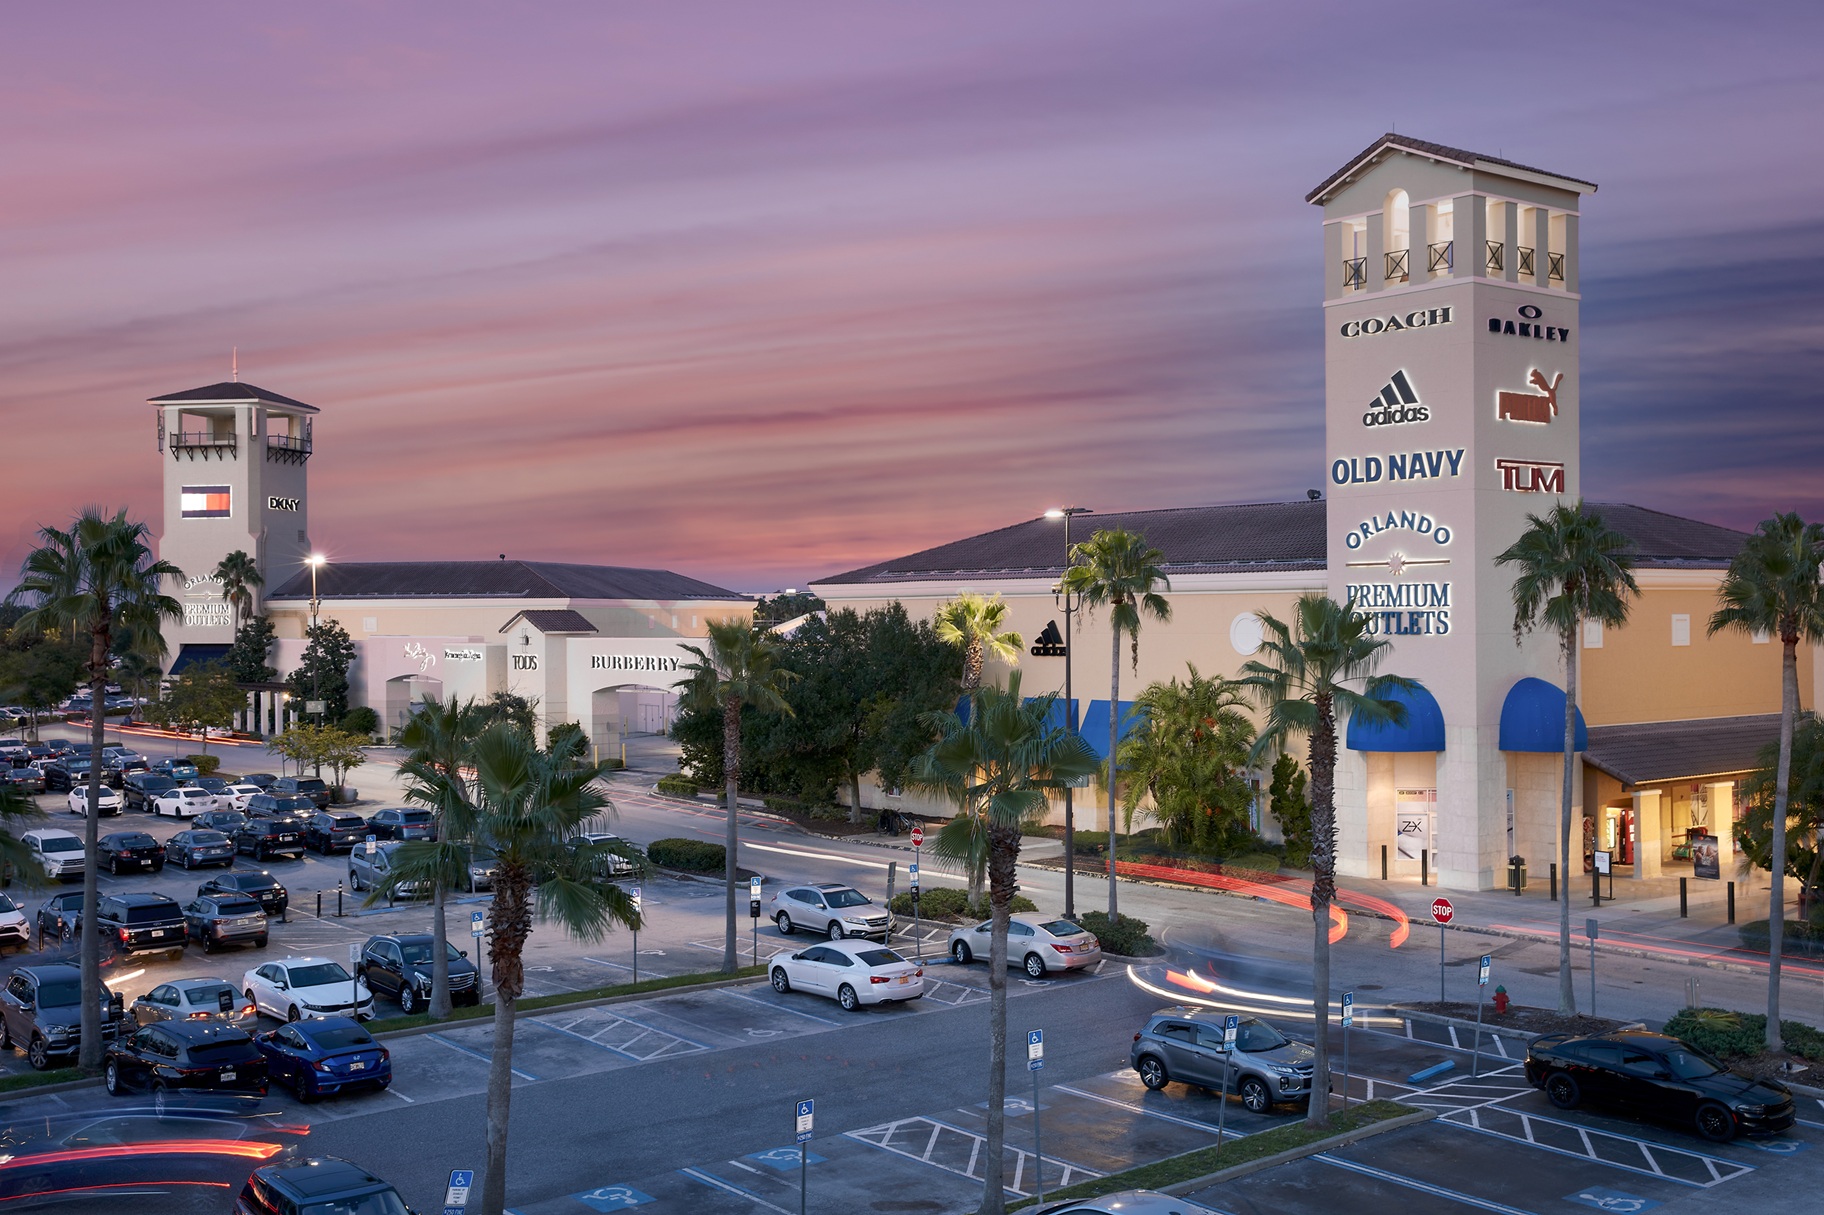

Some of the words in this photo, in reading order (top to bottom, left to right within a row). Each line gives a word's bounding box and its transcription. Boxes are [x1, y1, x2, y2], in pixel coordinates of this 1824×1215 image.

[1340, 306, 1452, 338] COACH
[1488, 318, 1570, 342] OAKLEY
[1362, 404, 1430, 427] adidas
[1331, 457, 1382, 485] OLD
[1388, 449, 1465, 481] NAVY
[269, 497, 300, 511] DKNY
[1345, 510, 1451, 549] ORLANDO
[184, 575, 226, 590] ORLAND
[1345, 583, 1450, 607] PREMIUM
[185, 603, 231, 614] PREMIUM
[185, 615, 231, 626] OUTLETS
[592, 655, 680, 671] BURBERRY
[911, 833, 923, 841] STOP
[1433, 904, 1452, 917] STOP
